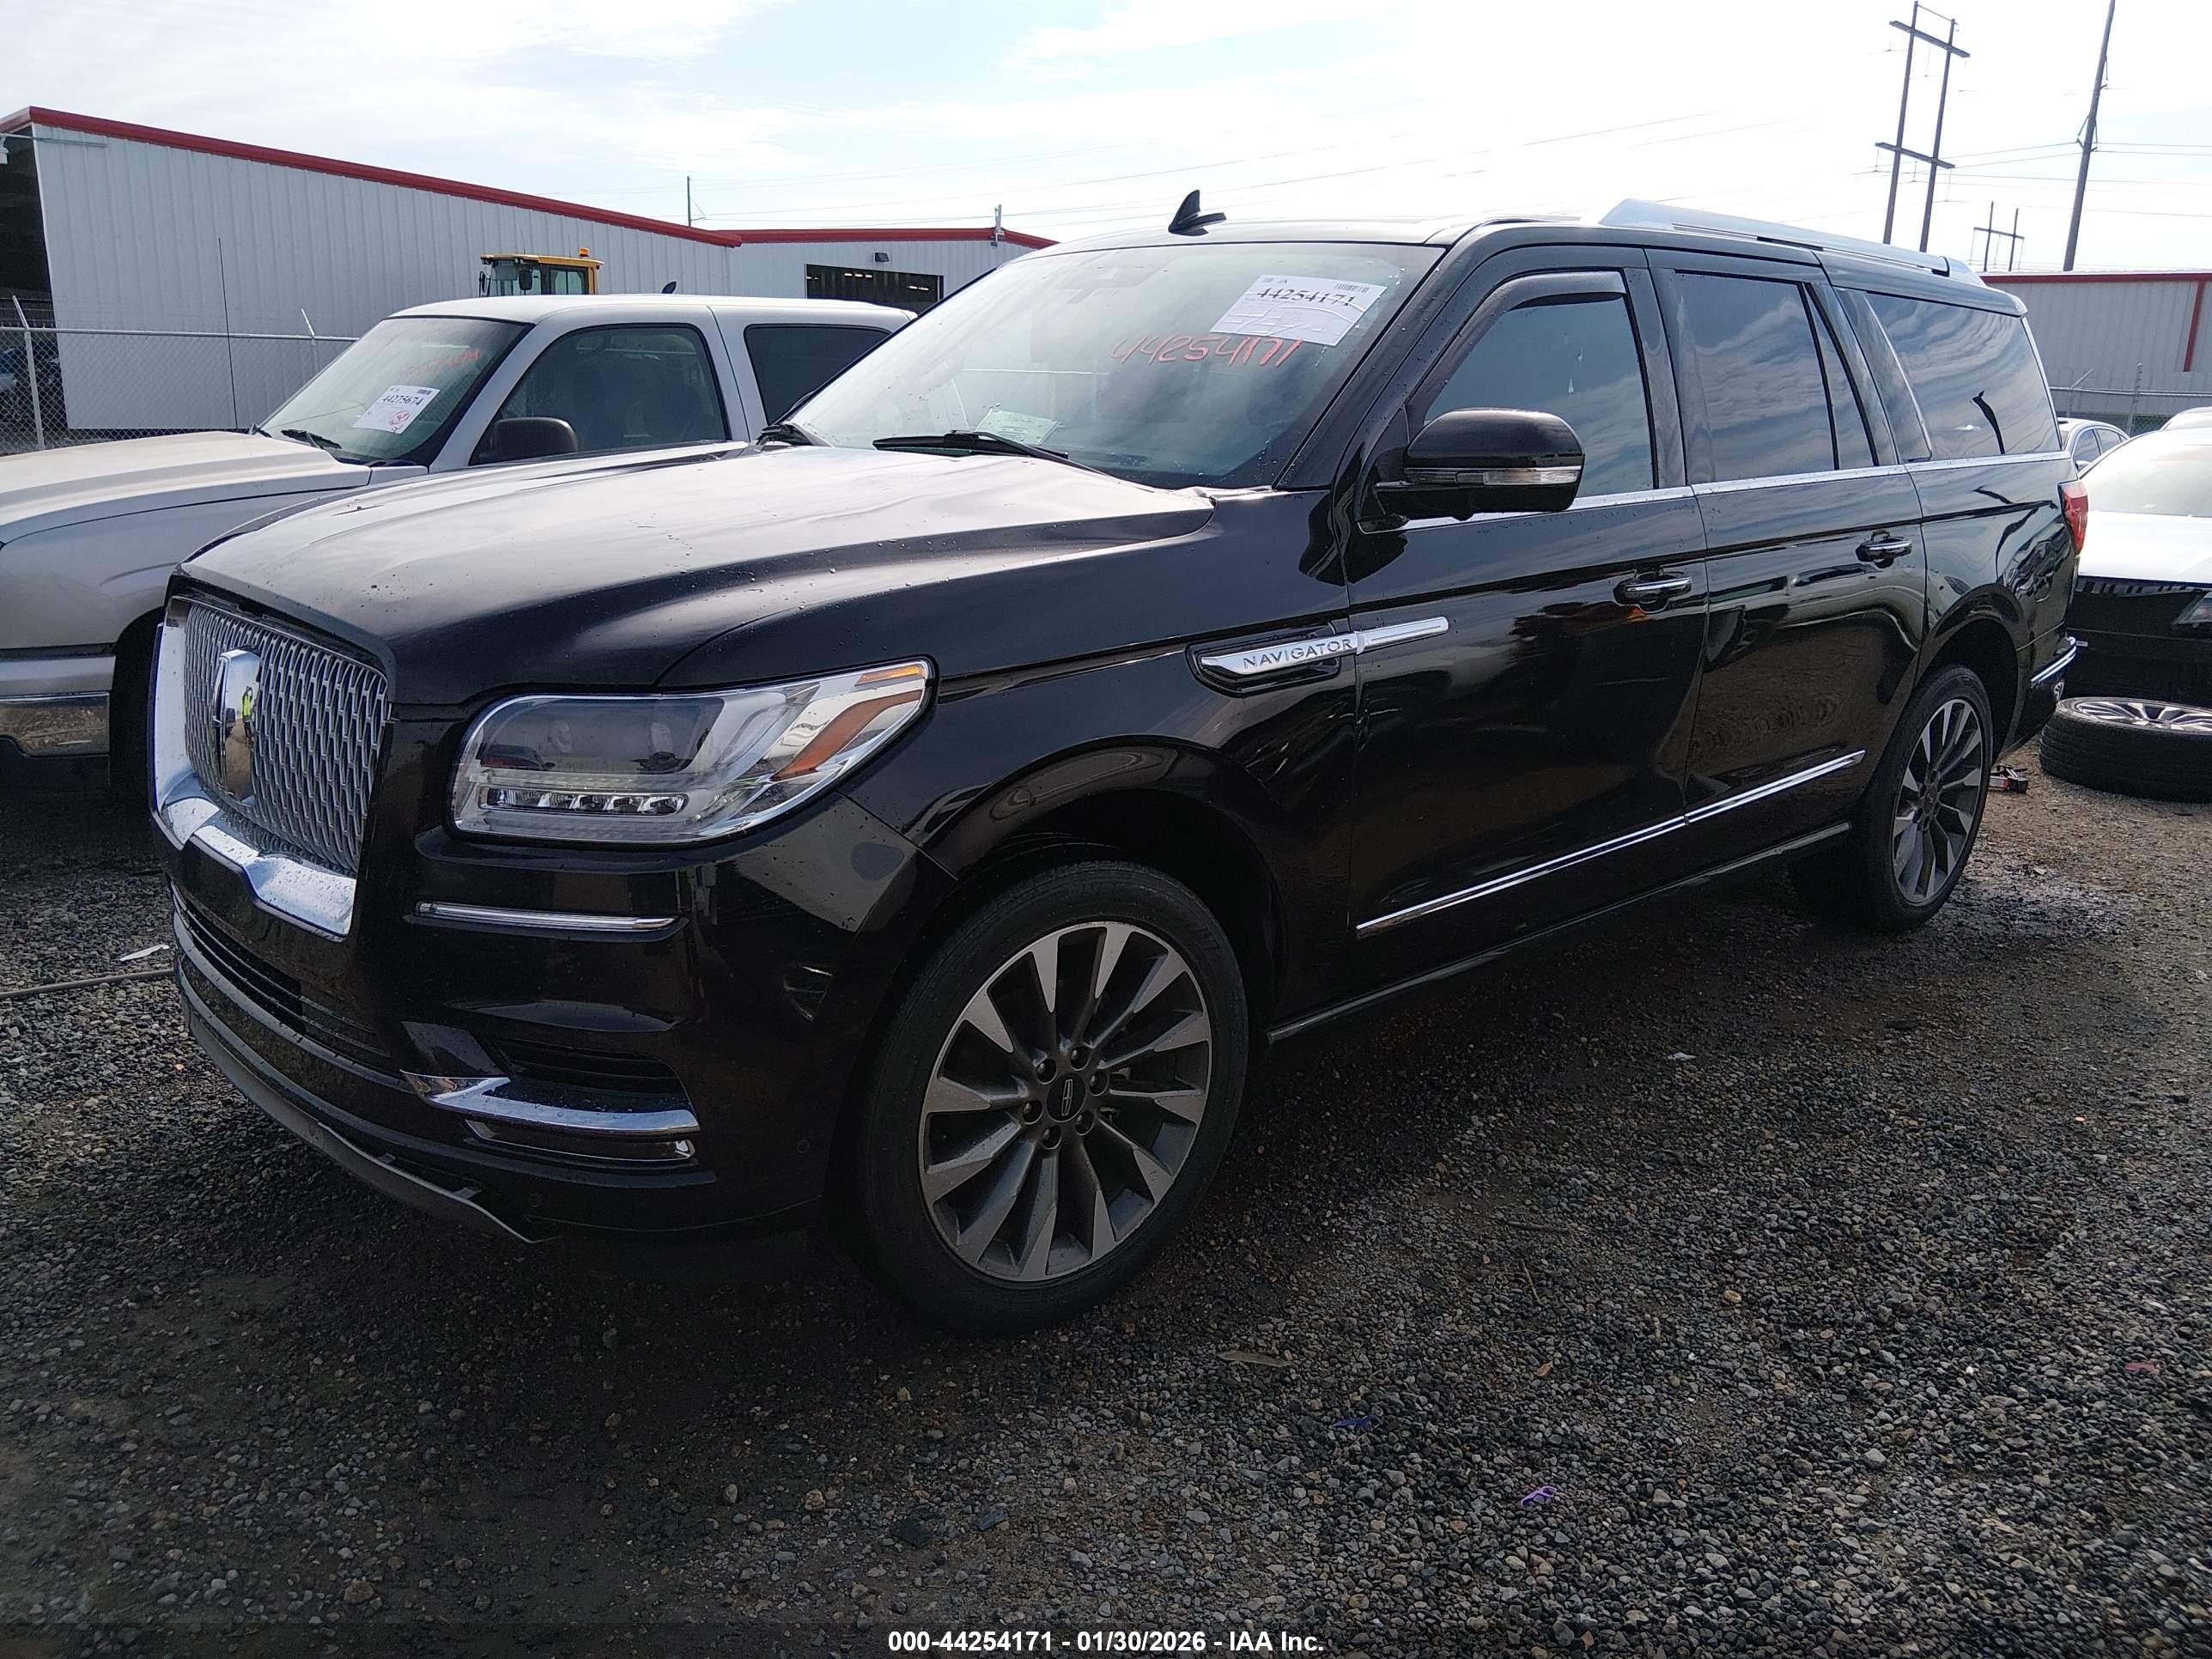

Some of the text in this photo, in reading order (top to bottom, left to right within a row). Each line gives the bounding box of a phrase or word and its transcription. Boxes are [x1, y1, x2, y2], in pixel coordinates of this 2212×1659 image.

[1257, 288, 1357, 307] 44254171
[1112, 333, 1304, 368] 44254171
[382, 394, 425, 406] 44275674
[1242, 637, 1352, 670] NAVIGATOR
